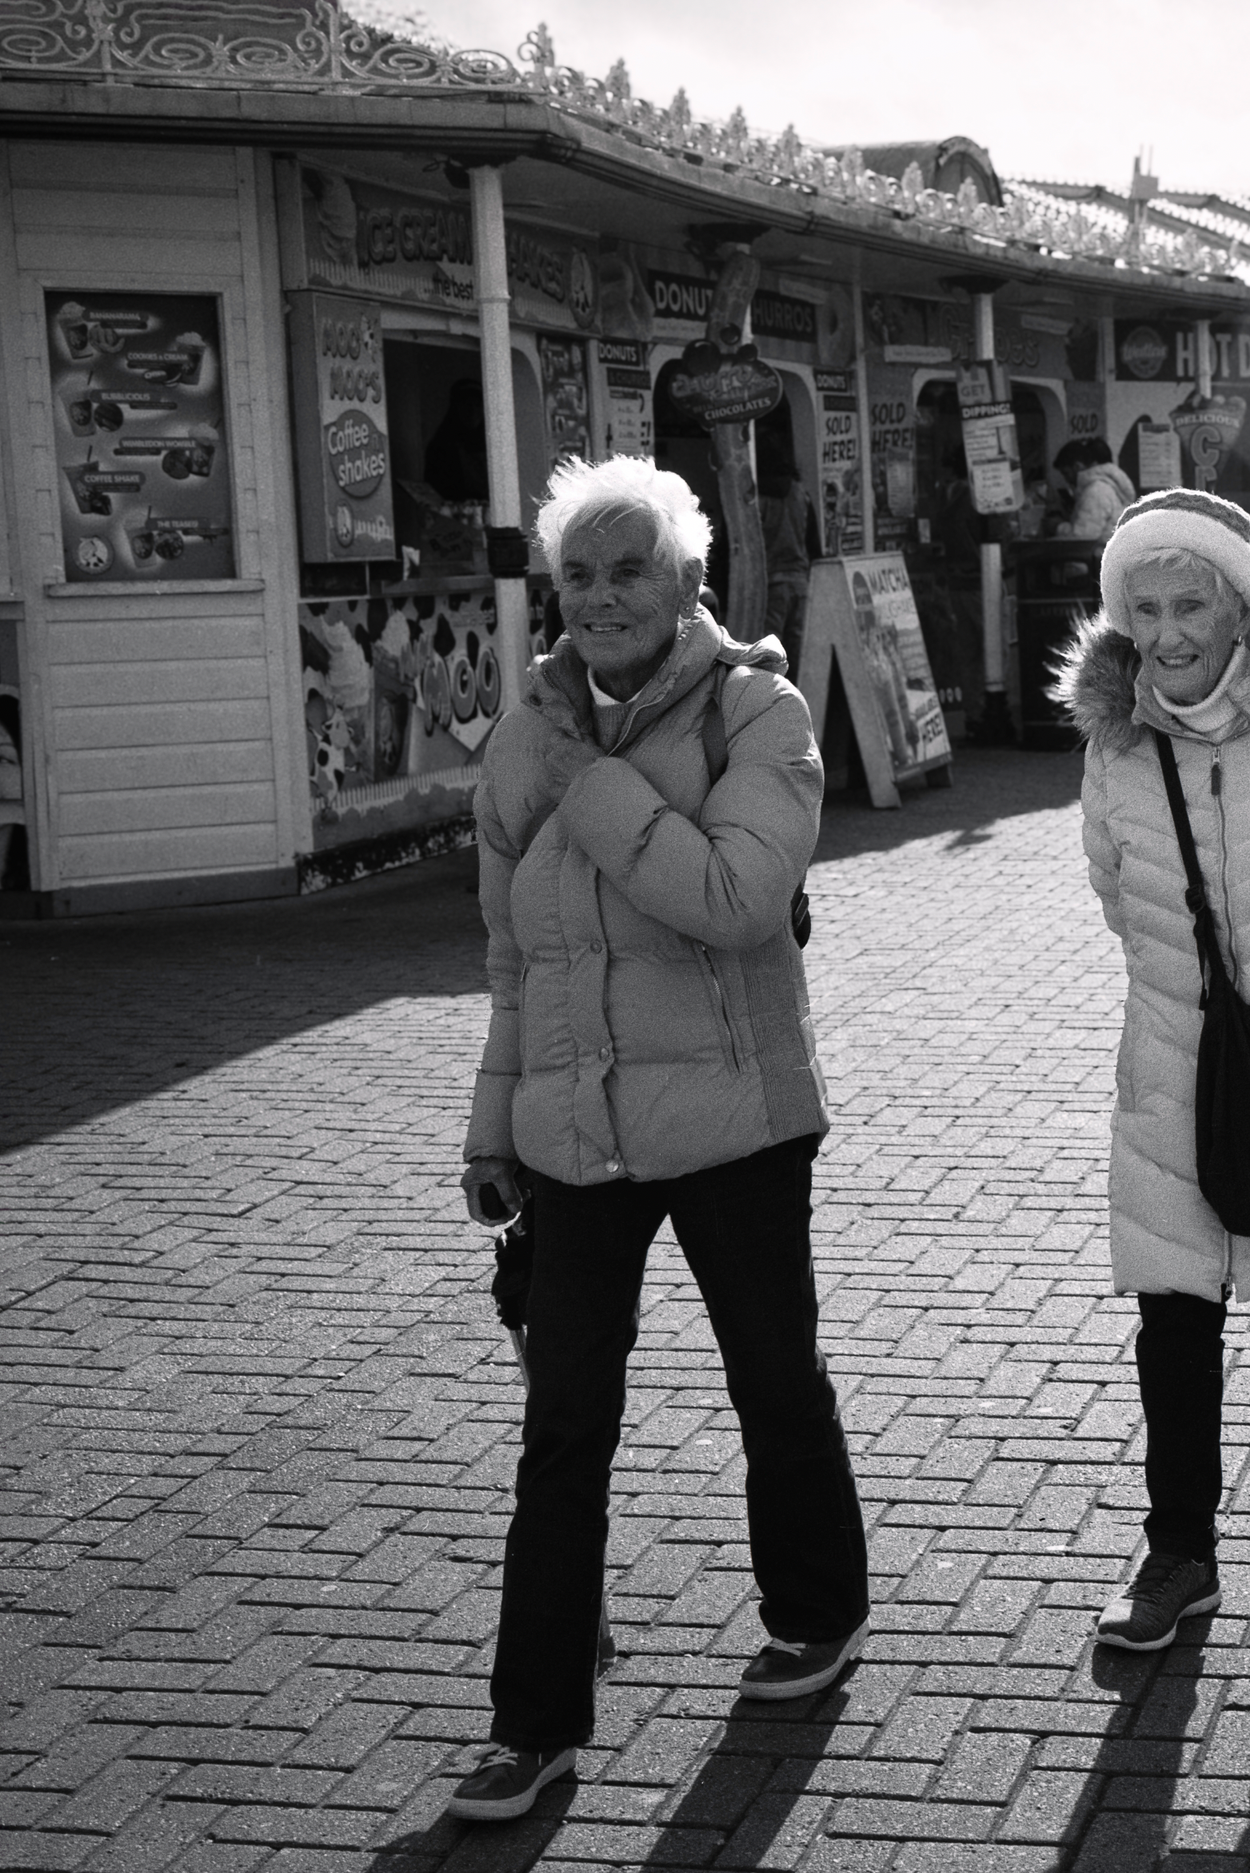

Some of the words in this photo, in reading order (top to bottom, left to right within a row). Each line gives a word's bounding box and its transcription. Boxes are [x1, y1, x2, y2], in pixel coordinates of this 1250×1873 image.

[507, 231, 566, 304] HAKES
[752, 298, 814, 334] HURROS
[322, 317, 361, 360] MOO
[598, 342, 638, 362] DONUTS
[816, 373, 846, 390] DONUTS
[961, 383, 986, 398] GET
[704, 397, 772, 420] CHOCOLATES
[871, 402, 906, 426] SOLD
[826, 415, 852, 436] SOLD
[1070, 413, 1099, 435] SOLD
[1175, 413, 1240, 429] DELICIOUS
[328, 419, 370, 455] Coffee
[84, 474, 113, 484] COFFEE
[114, 474, 140, 484] SHAKE
[338, 450, 386, 487] shakes
[868, 566, 909, 595] MATCHA
[421, 648, 502, 738] MOO
